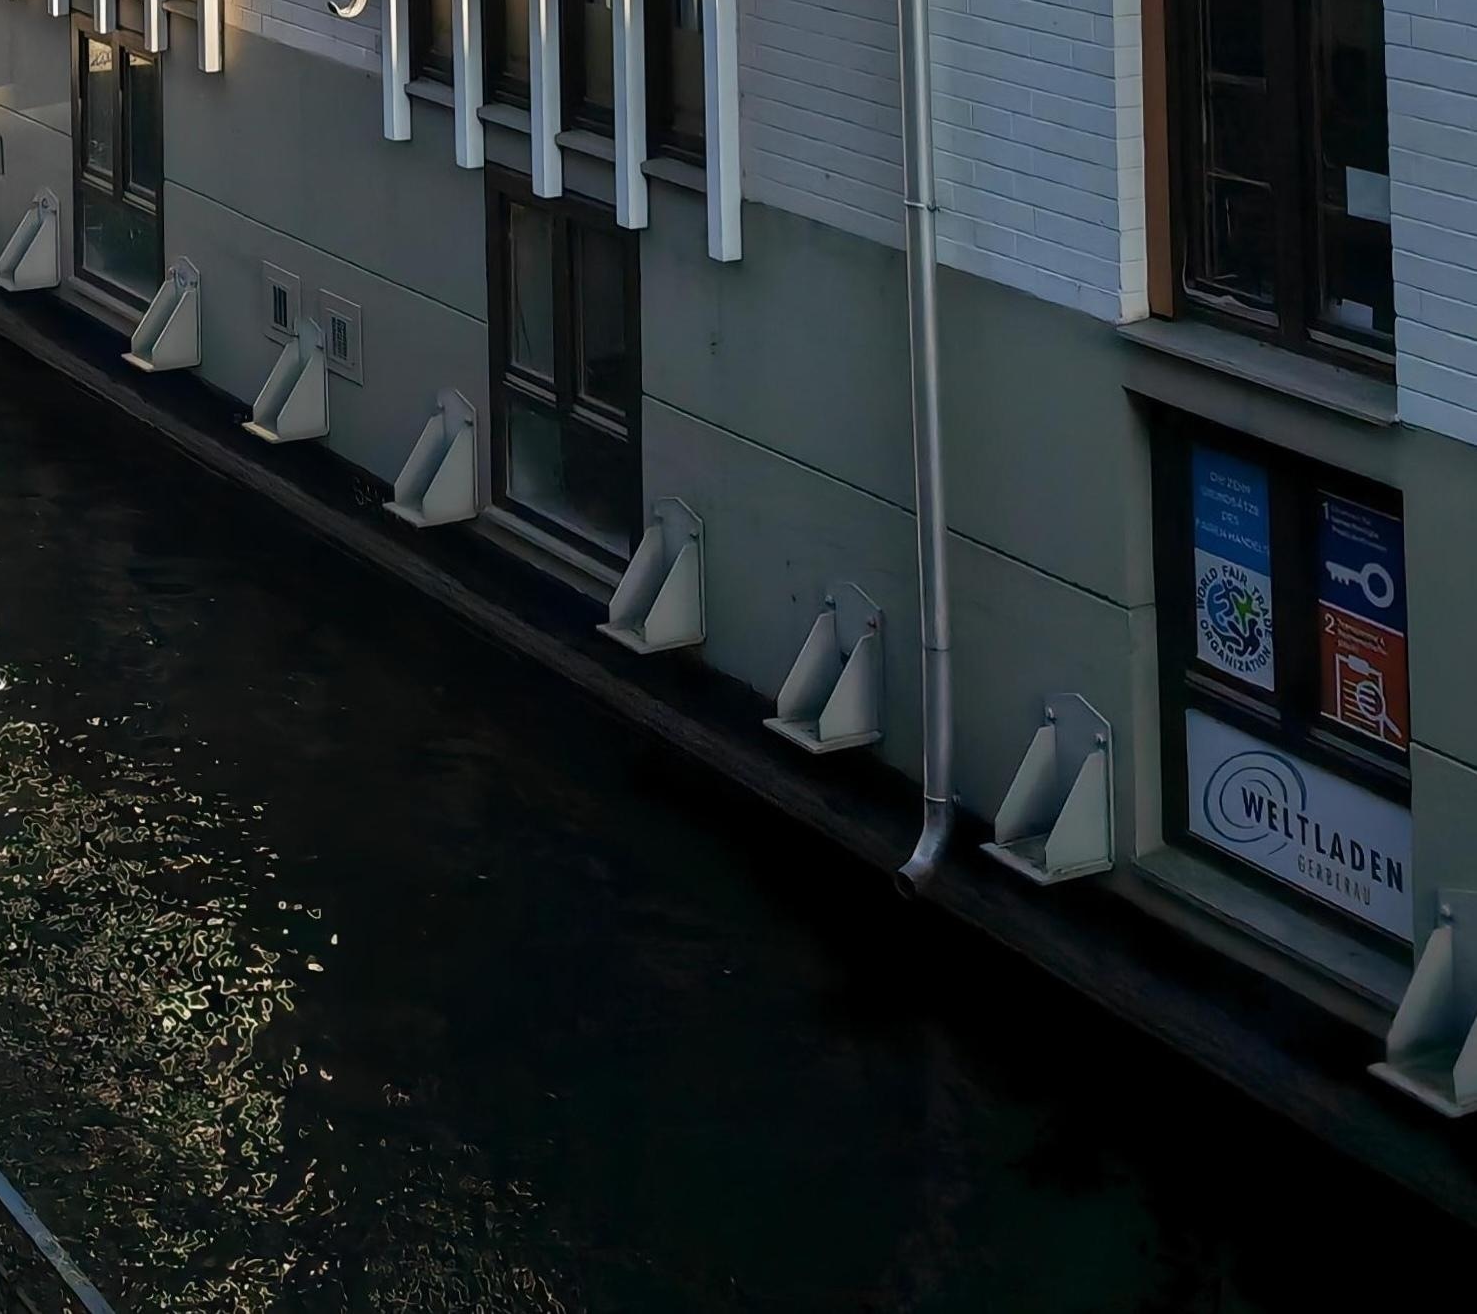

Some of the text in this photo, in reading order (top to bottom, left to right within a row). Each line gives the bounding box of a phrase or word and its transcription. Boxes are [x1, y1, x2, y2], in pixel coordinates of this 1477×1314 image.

[1323, 501, 1329, 520] 1
[1196, 565, 1273, 637] WORLD FAIR TRADE
[1325, 613, 1335, 635] 2
[1200, 620, 1272, 673] ORGANIZATION
[1241, 786, 1403, 893] WELTLADEN
[1298, 853, 1371, 906] GERBERAU
